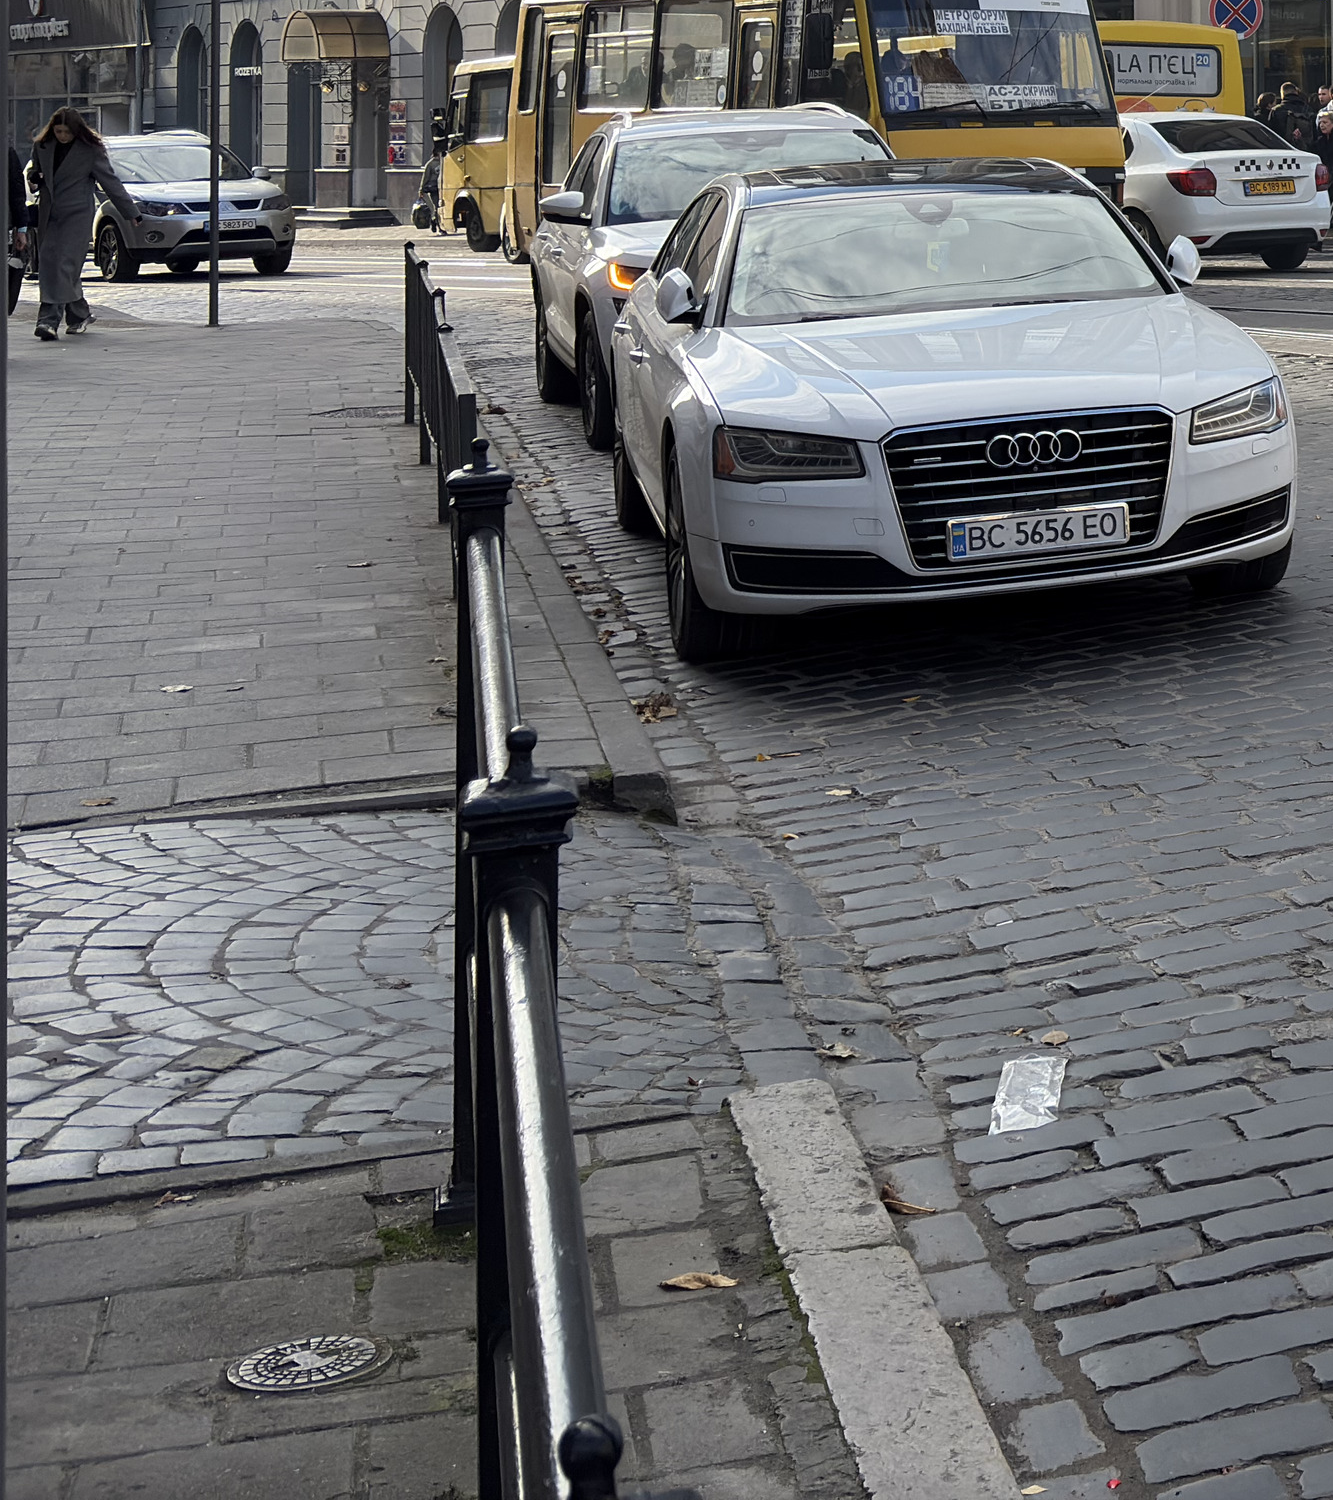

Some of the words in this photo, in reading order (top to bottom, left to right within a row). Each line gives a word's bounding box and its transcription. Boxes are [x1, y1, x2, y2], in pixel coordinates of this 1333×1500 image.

[934, 9, 971, 21] МЕТРО
[972, 9, 1007, 21] ФОРУМ
[936, 22, 973, 34] ЗАХІДНА
[974, 25, 1009, 35] ЛЬВІВ
[1117, 54, 1142, 73] LA
[1196, 54, 1210, 66] 20
[234, 66, 263, 77] ROZETKA
[1117, 78, 1153, 87] нормальна
[884, 75, 922, 111] 184
[988, 85, 1022, 97] АС-2
[1022, 85, 1057, 97] СКРИНЯ
[990, 99, 1023, 110] БТІ
[1249, 183, 1261, 192] BC
[1262, 182, 1280, 192] 6189
[1281, 182, 1291, 191] MI
[222, 221, 241, 230] 5823
[242, 220, 254, 229] PO
[968, 524, 1006, 551] BC
[1014, 516, 1075, 546] 5656
[1082, 512, 1117, 539] EO
[953, 544, 965, 553] UA
